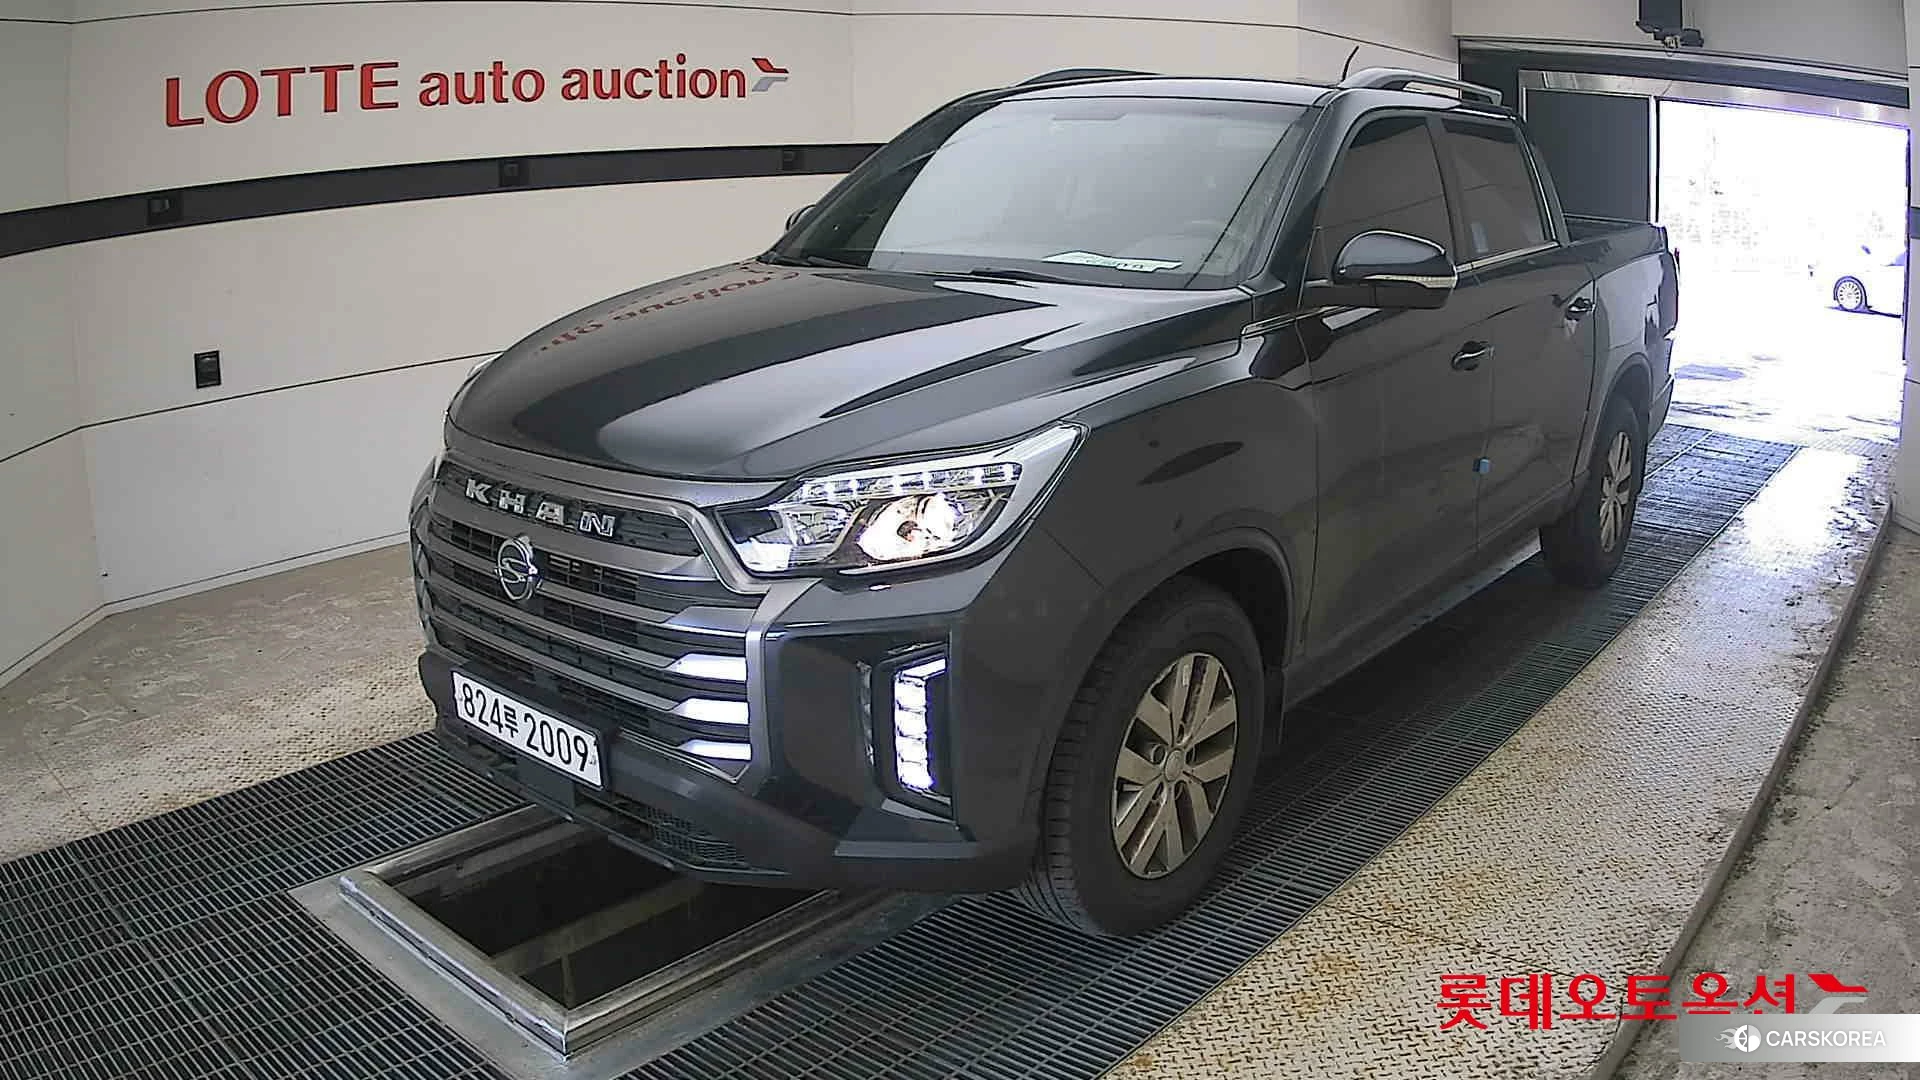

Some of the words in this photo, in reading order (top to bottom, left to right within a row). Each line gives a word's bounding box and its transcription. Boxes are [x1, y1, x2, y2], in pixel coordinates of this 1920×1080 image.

[165, 61, 400, 128] LOTTE
[418, 60, 546, 107] auto
[560, 53, 747, 101] auction
[465, 478, 616, 537] KHAN
[523, 712, 589, 772] 2009
